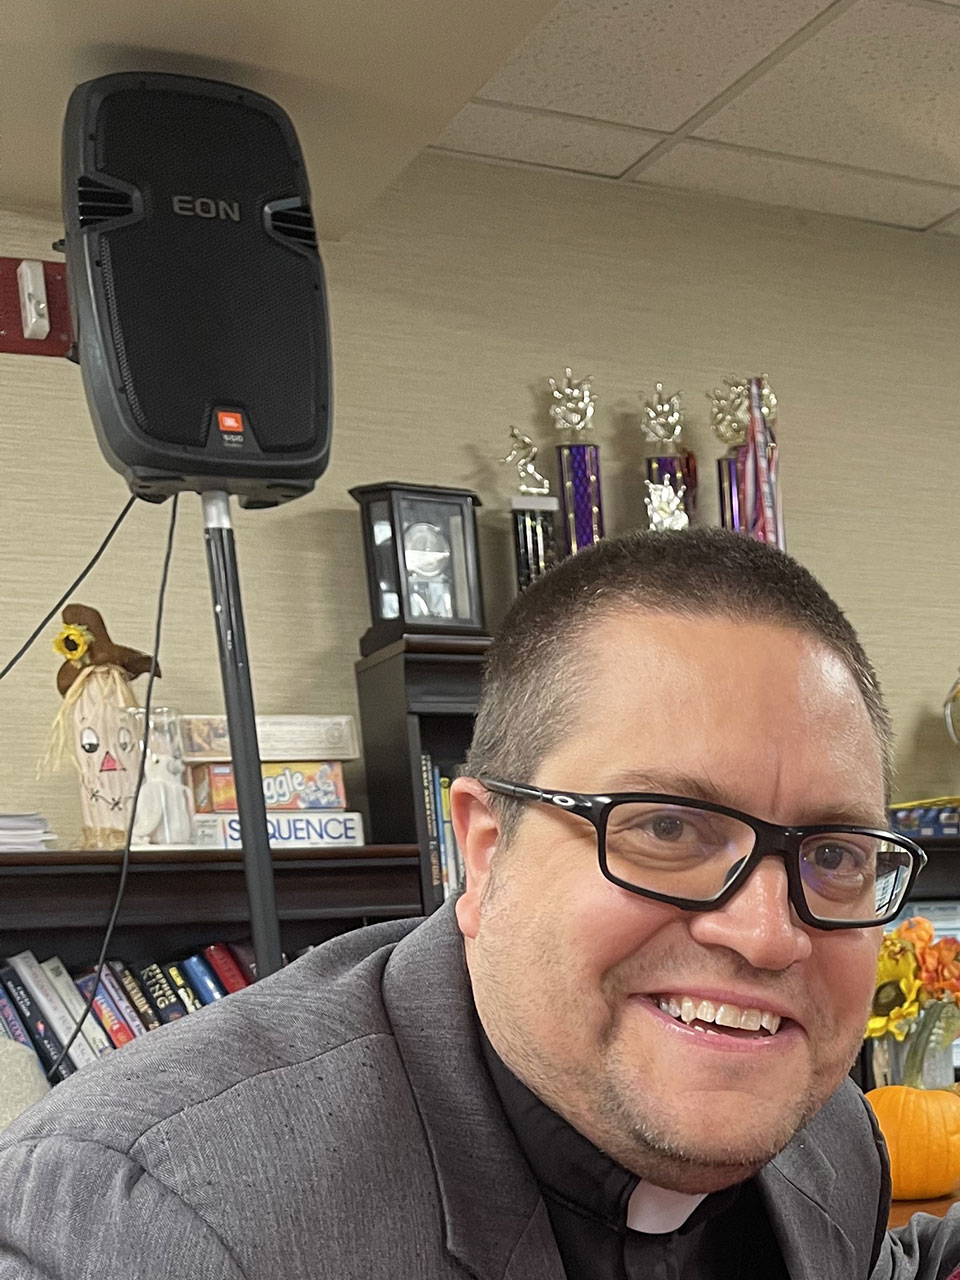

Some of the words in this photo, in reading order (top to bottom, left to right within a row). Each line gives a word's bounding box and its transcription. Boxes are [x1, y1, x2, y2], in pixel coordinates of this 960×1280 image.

[172, 195, 241, 222] EON
[263, 769, 305, 803] ggle
[228, 818, 356, 841] SQUENCE
[139, 967, 170, 1010] KING
[149, 963, 178, 1004] STEPHEN
